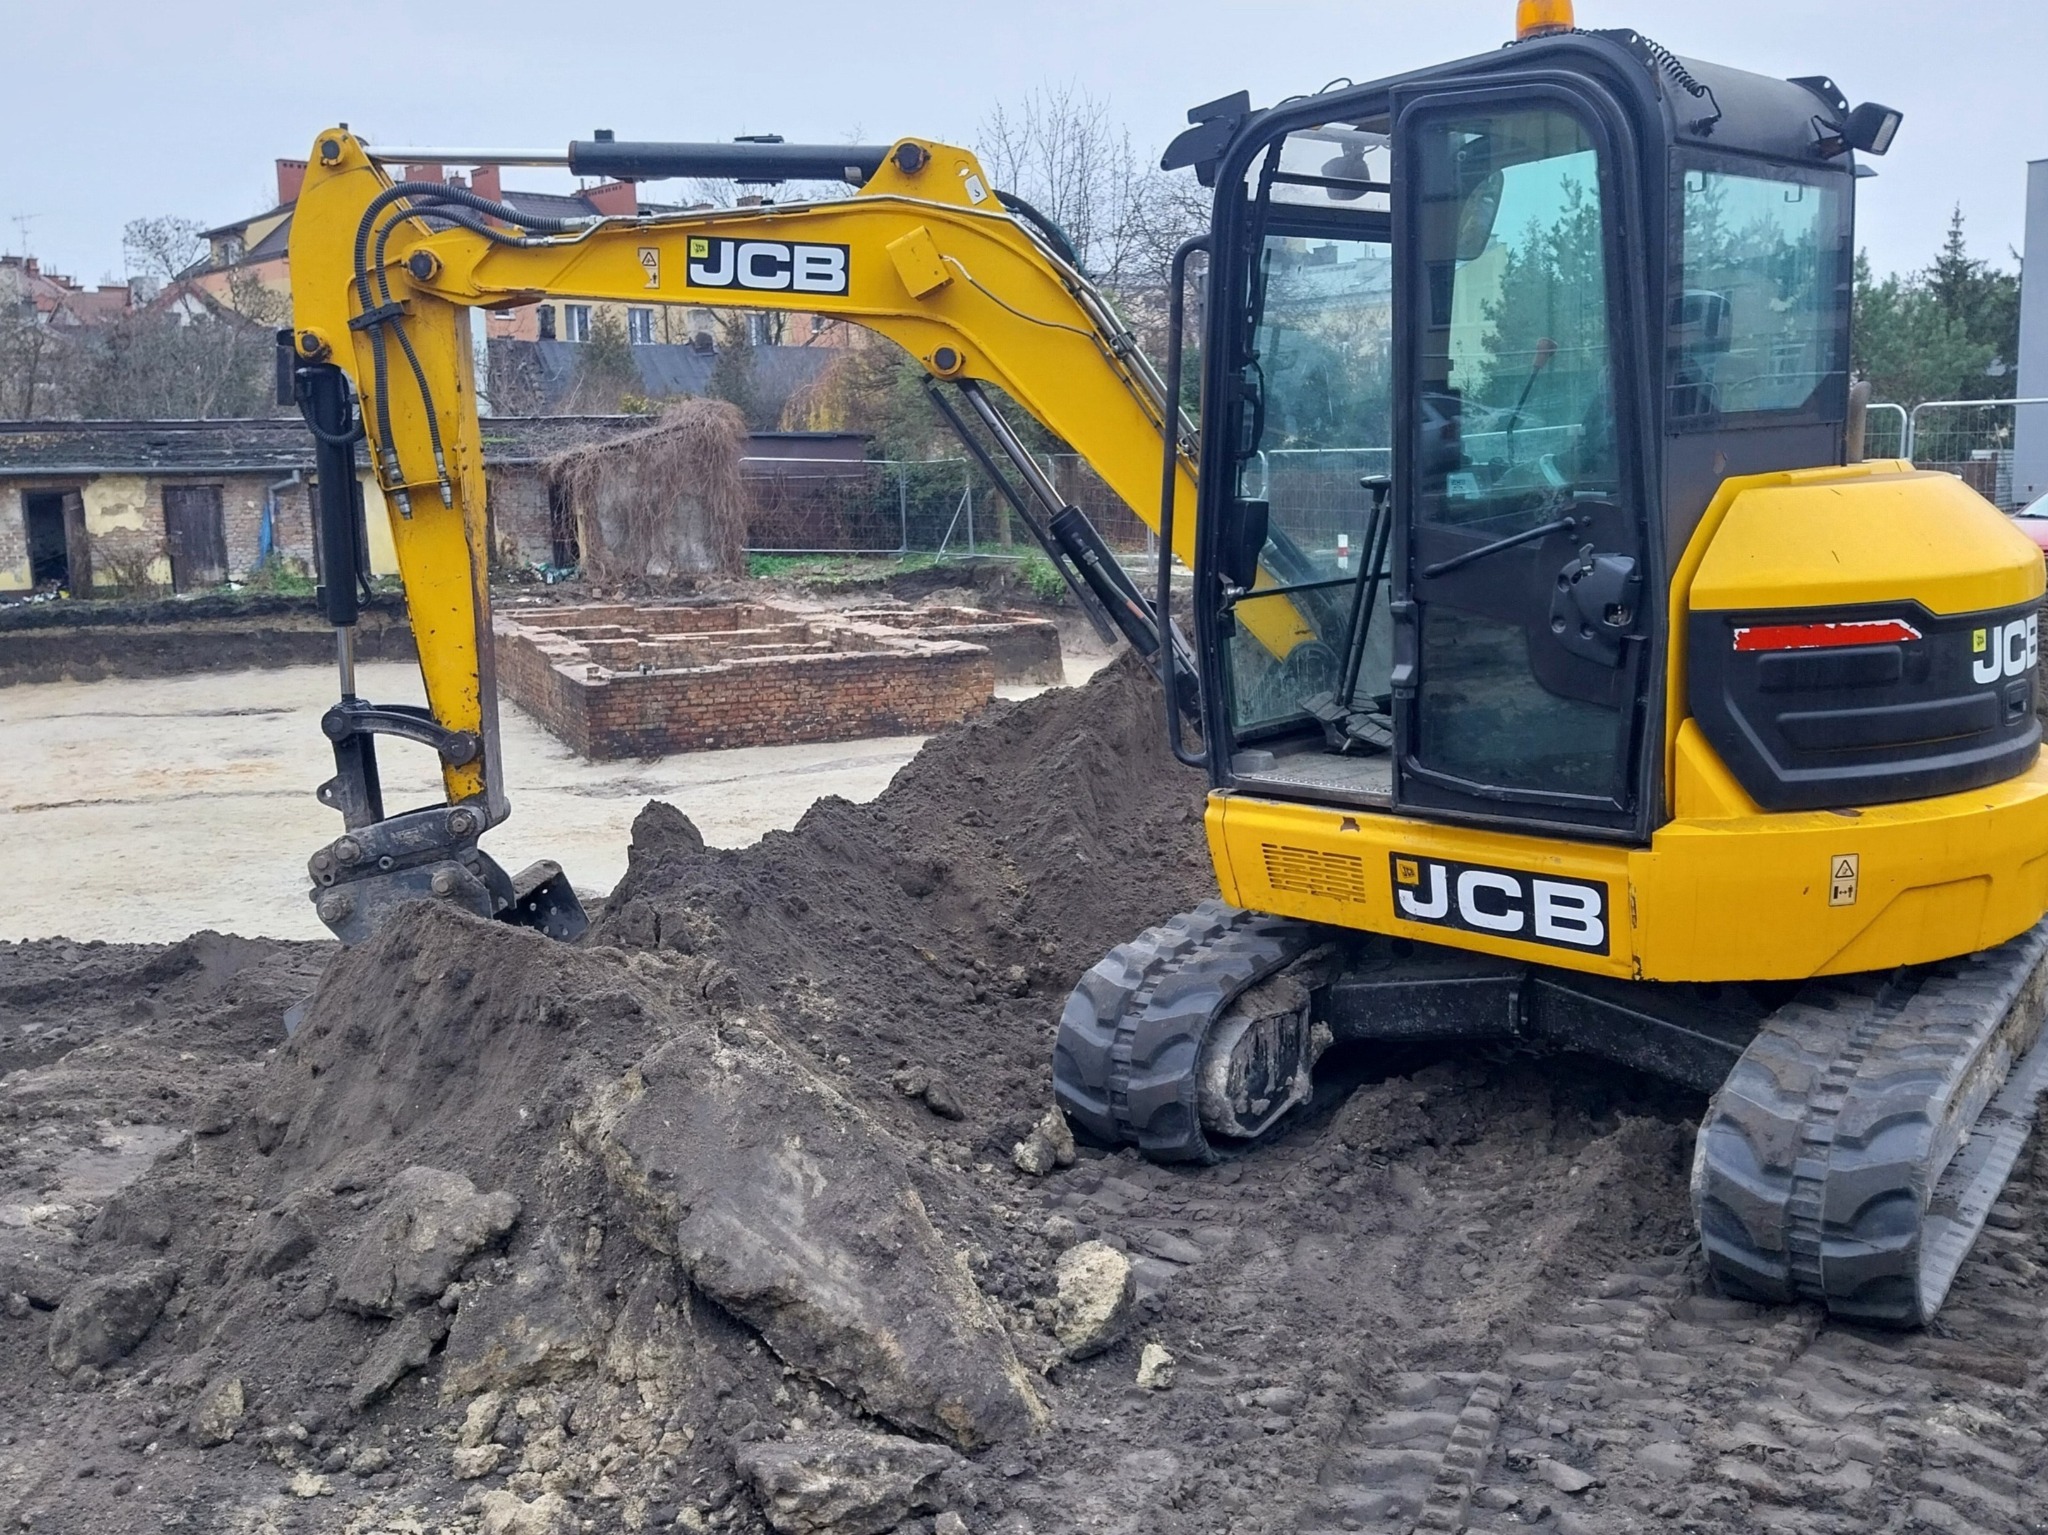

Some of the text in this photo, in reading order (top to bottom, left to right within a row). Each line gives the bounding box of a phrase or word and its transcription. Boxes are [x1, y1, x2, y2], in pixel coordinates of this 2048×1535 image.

[690, 241, 846, 292] JCB
[1973, 613, 2038, 684] JCB
[1398, 864, 1605, 946] JCB
